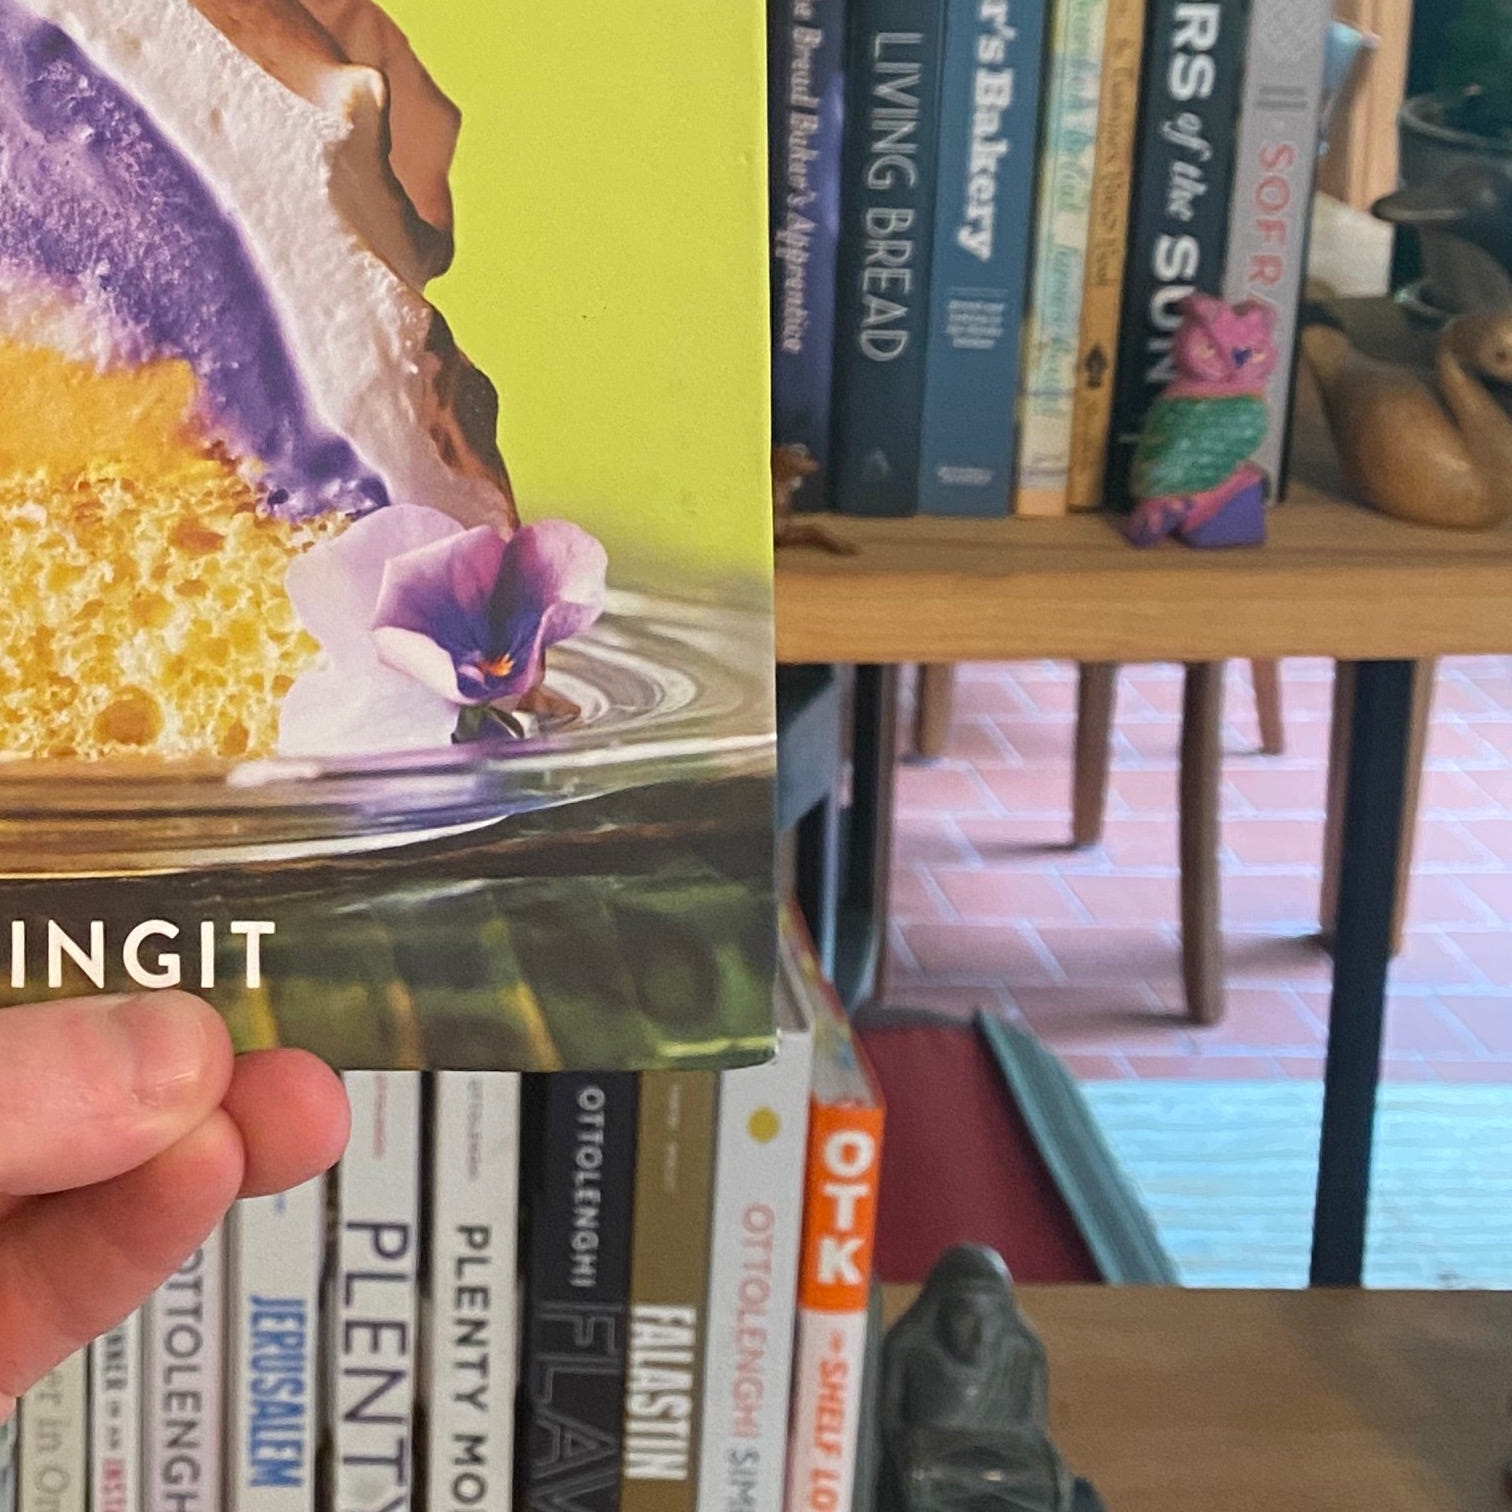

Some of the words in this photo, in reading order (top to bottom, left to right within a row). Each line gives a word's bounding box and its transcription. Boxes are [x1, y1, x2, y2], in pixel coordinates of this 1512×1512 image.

[791, 25, 826, 110] Bread
[866, 31, 925, 191] LIVING
[1161, 111, 1213, 161] of
[786, 112, 821, 208] Baker's
[956, 66, 1016, 262] Bakery
[1165, 161, 1209, 222] the
[1247, 142, 1297, 296] SOFR
[775, 213, 818, 355] Apprentice
[859, 207, 914, 364] BREAD
[1144, 234, 1199, 385] SUN
[570, 1087, 607, 1290] OTTOLENGHI
[814, 1129, 876, 1286] OTK
[248, 1294, 307, 1489] JERUSALEM
[452, 1224, 492, 1412] PLENTY
[623, 1303, 698, 1482] FALASTIN
[733, 1202, 777, 1440] OTTOLENGHI
[37, 1417, 73, 1454] in
[452, 1433, 488, 1512] MO
[726, 1446, 762, 1512] SIM
[813, 1358, 851, 1457] SHELF
[101, 1457, 128, 1512] INST
